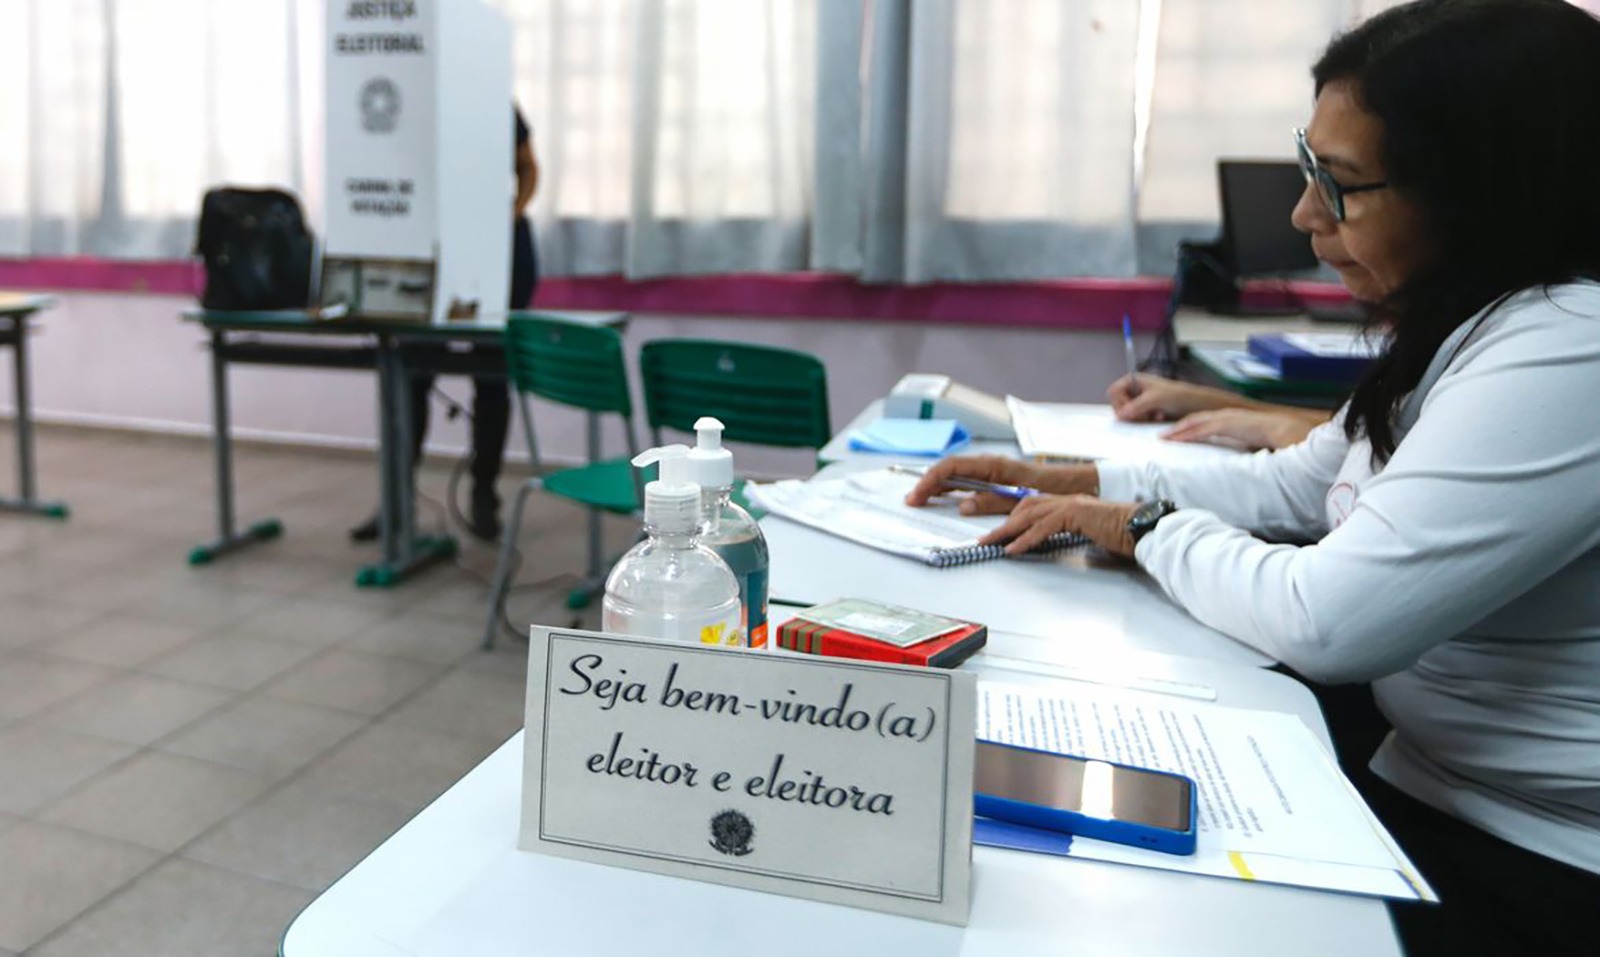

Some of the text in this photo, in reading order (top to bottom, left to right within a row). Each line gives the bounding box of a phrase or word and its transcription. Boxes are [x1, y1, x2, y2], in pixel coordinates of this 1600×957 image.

[559, 653, 646, 710] Seja
[659, 662, 936, 743] bem-vindo(a)
[585, 732, 895, 816] eleitor e eleitora
